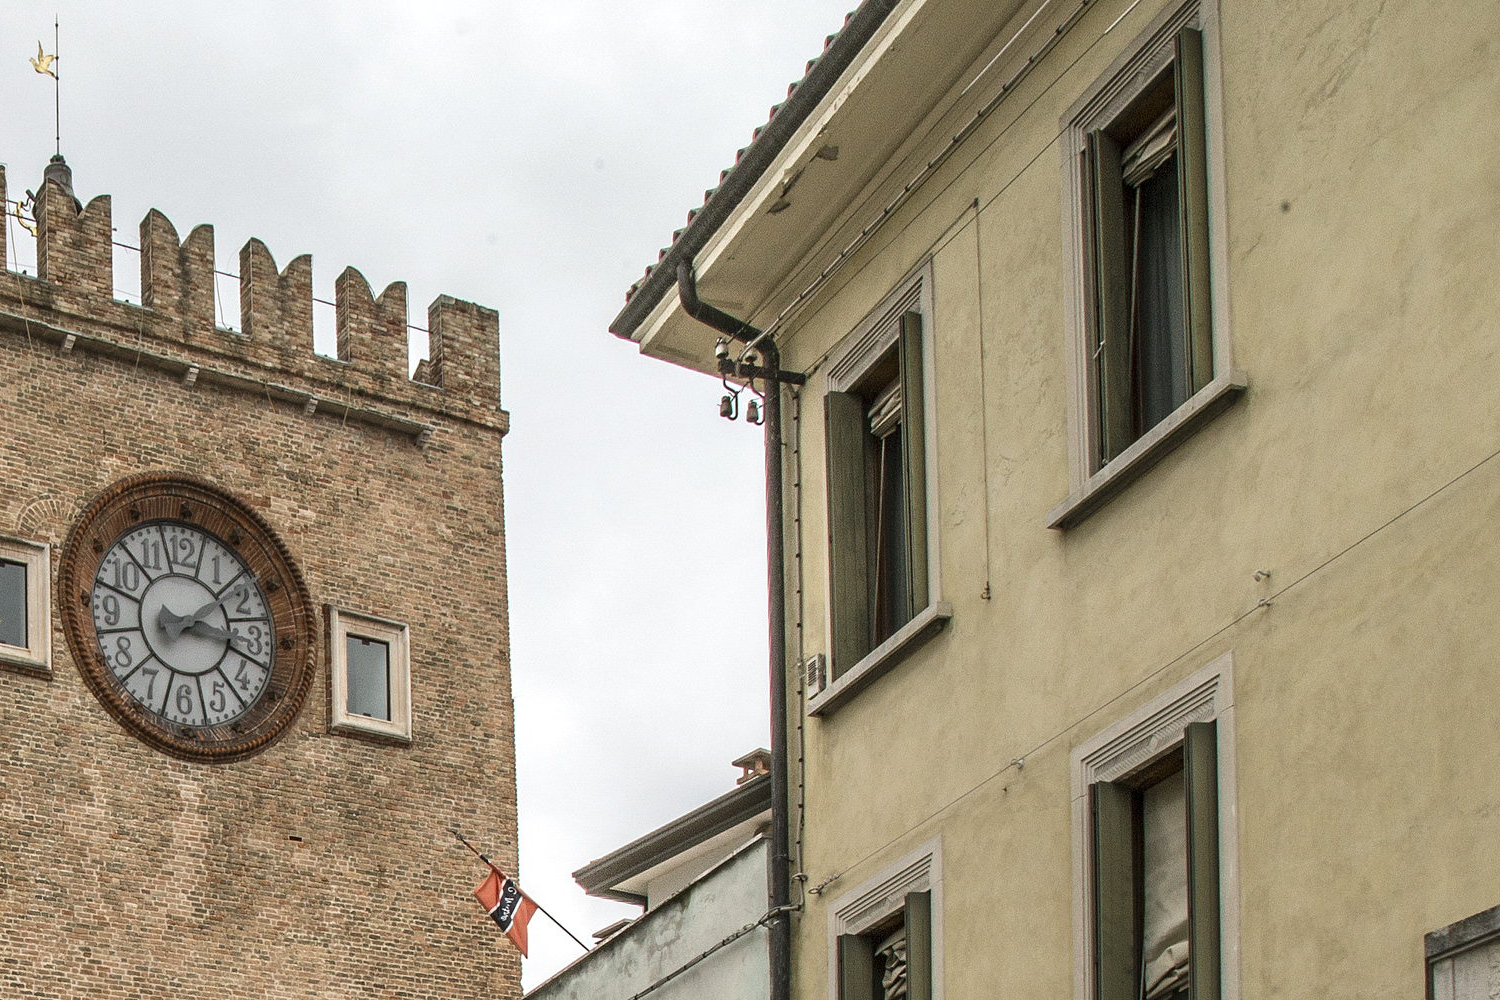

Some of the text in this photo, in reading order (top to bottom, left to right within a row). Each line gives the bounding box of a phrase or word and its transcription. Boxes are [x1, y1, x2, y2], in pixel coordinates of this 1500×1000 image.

[140, 538, 162, 571] 11
[170, 534, 197, 569] 12
[112, 557, 140, 592] 10
[211, 555, 222, 585] 1
[102, 595, 121, 626] 9
[234, 584, 252, 615] 2
[115, 636, 133, 668] 8
[245, 625, 263, 656] 3
[141, 667, 159, 700] 7
[234, 659, 251, 691] 4
[176, 684, 193, 715] 6
[209, 681, 226, 713] 5
